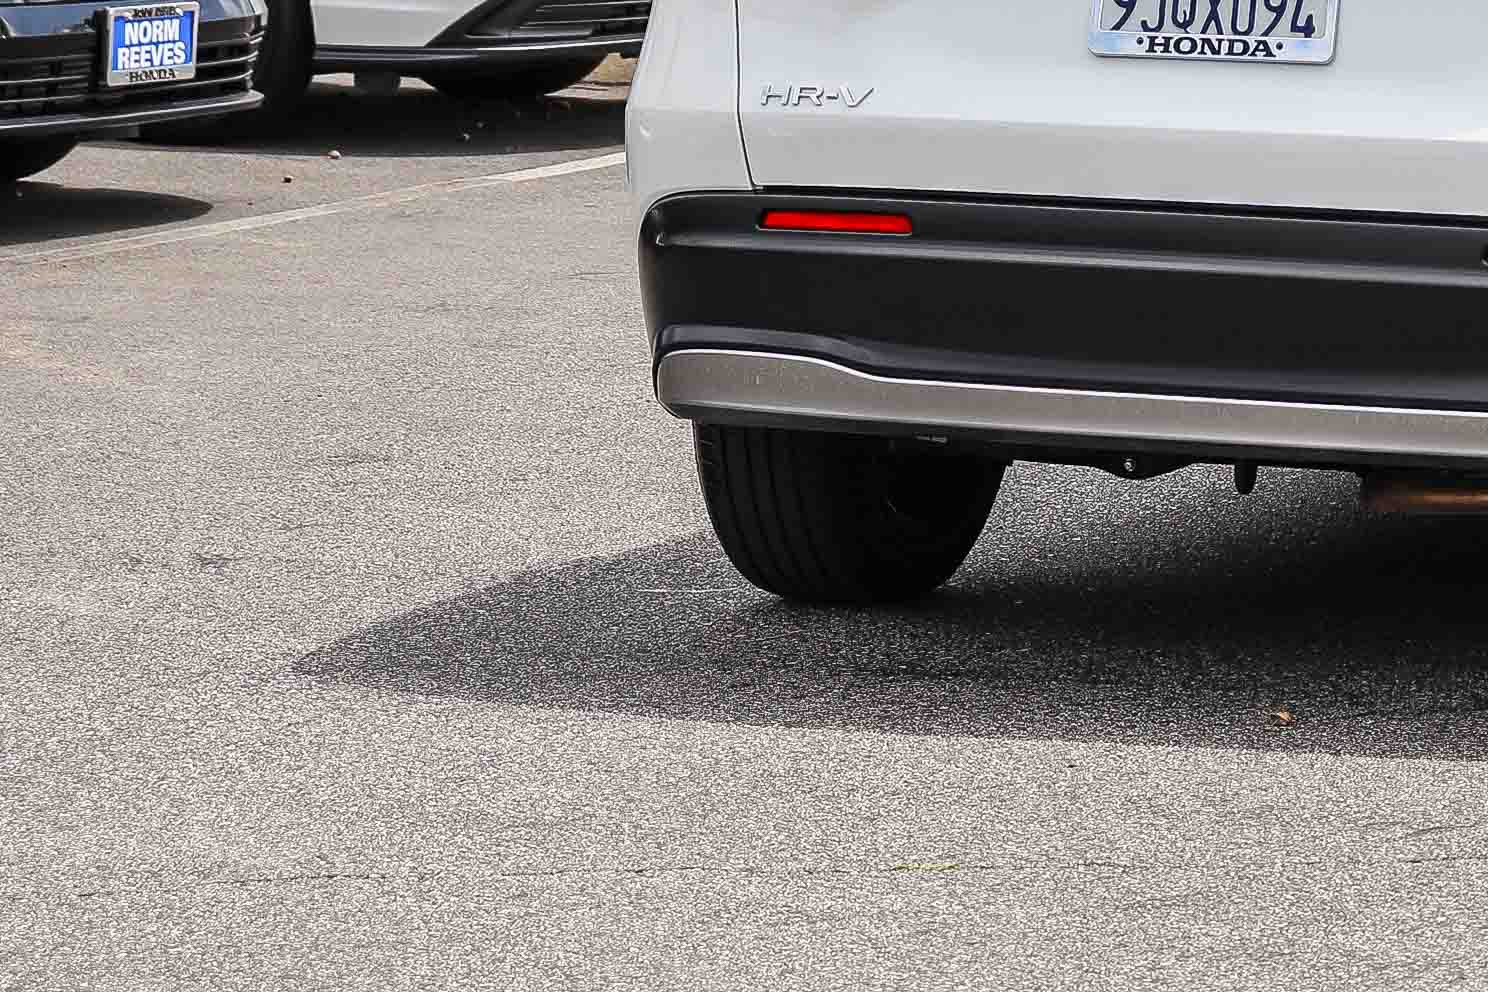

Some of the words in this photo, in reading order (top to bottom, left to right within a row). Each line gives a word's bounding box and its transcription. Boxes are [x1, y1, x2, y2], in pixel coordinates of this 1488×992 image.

[124, 19, 180, 46] NORM
[117, 42, 186, 70] REEVES
[1145, 35, 1276, 58] HONDA
[760, 83, 875, 108] HR-V
